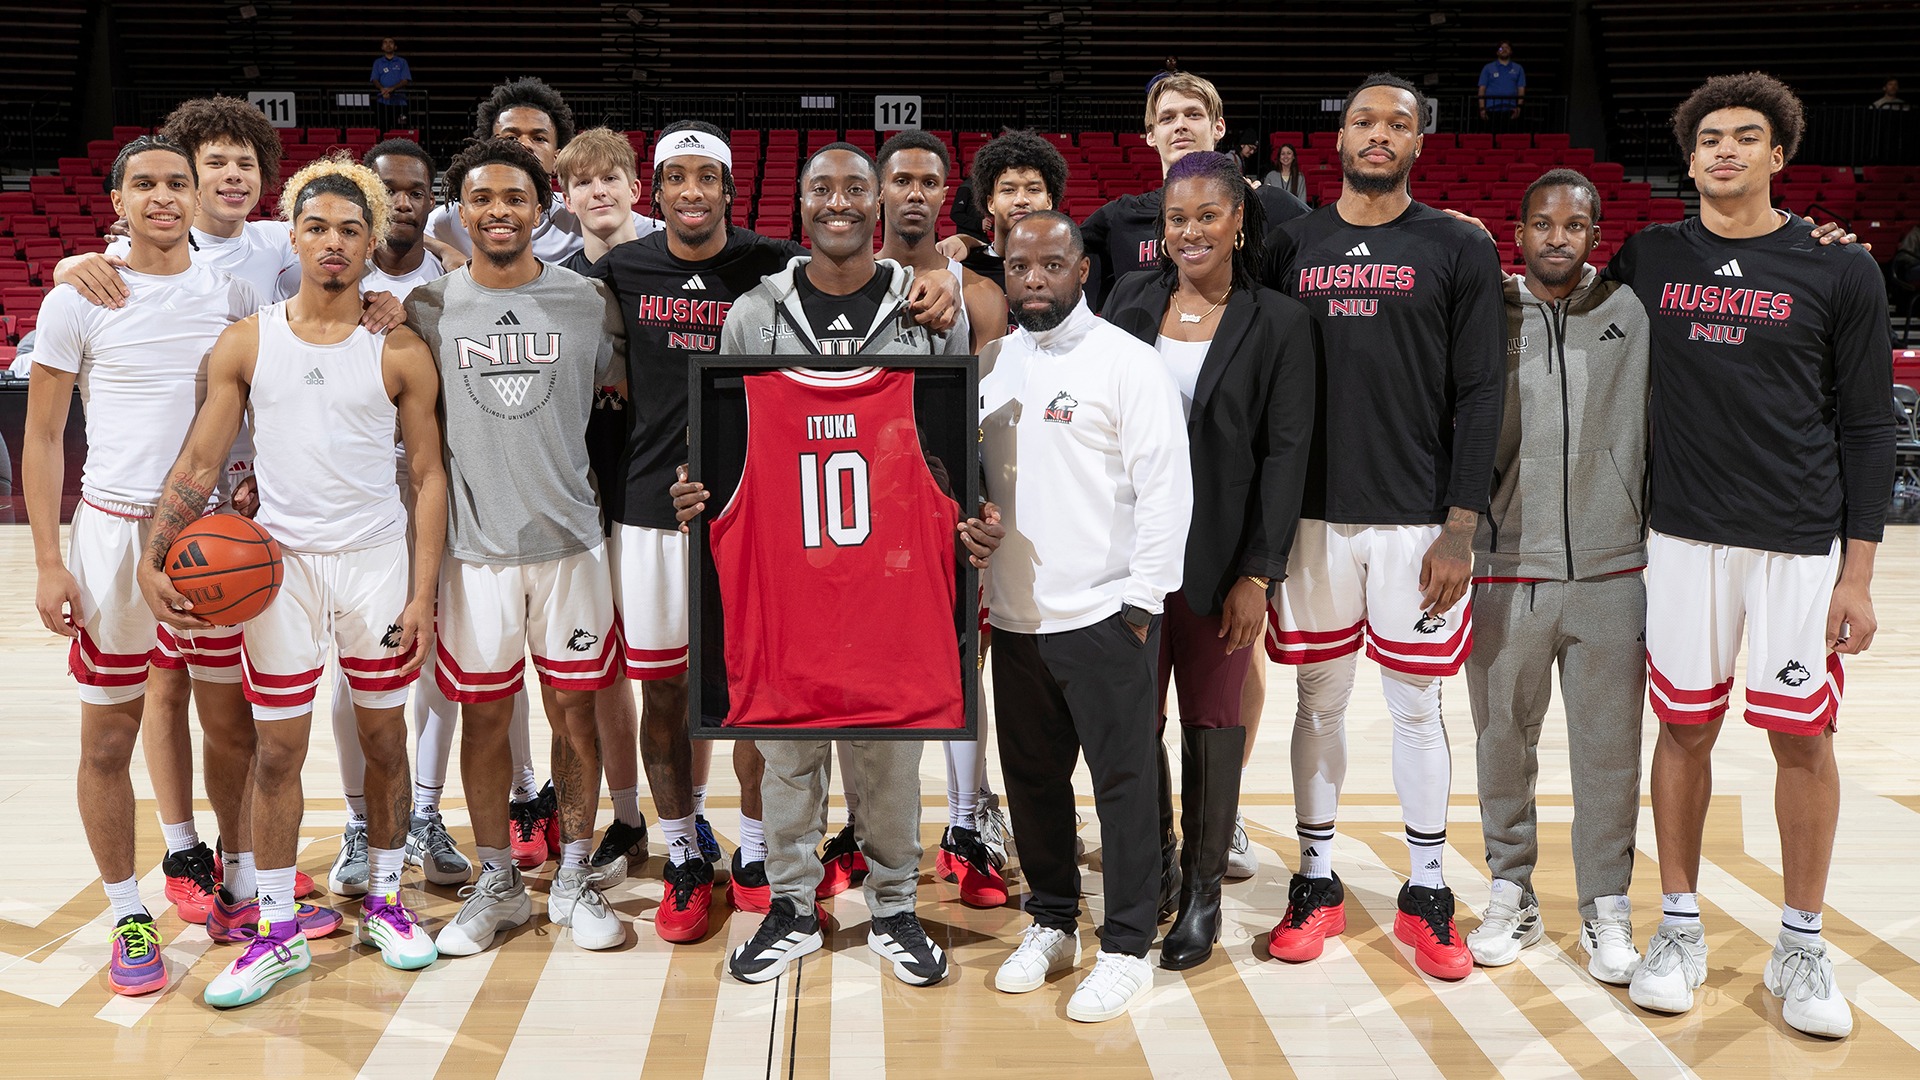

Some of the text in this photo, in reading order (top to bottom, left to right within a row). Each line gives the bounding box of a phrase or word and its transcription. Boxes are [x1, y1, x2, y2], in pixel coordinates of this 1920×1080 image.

[880, 102, 917, 125] 112
[674, 142, 705, 150] adidas
[1299, 264, 1416, 292] HUSKIES
[638, 294, 732, 327] HUSKIE
[1328, 298, 1379, 317] NIU
[1660, 282, 1794, 320] HUSKIES
[667, 331, 717, 351] NIU
[1507, 335, 1529, 351] IU
[1688, 321, 1747, 346] NIU
[453, 332, 562, 370] NIU
[463, 374, 480, 405] NORTHERN
[480, 404, 506, 419] ILLINOIS
[542, 369, 557, 407] BASKETBALL
[807, 413, 857, 440] ITUKA
[1044, 408, 1073, 422] NIU
[799, 449, 872, 549] 10
